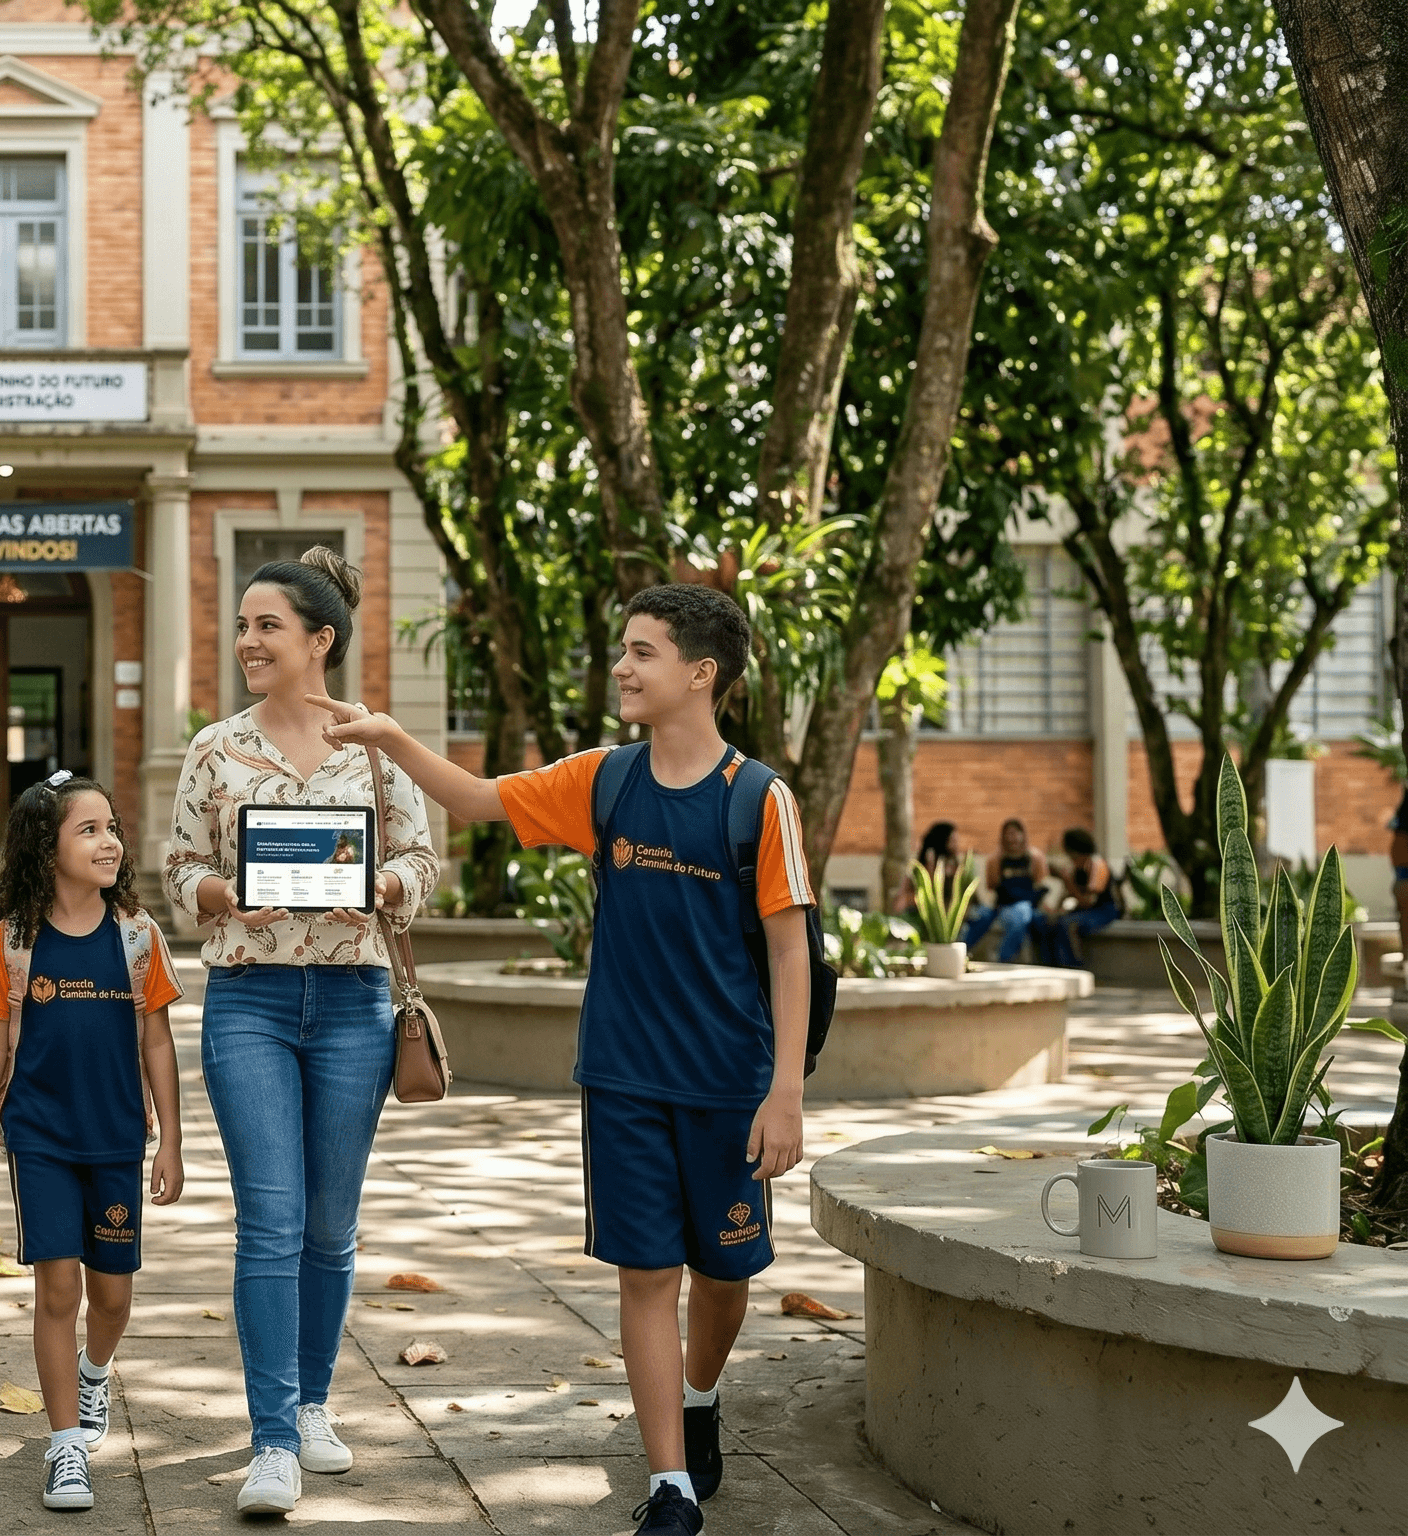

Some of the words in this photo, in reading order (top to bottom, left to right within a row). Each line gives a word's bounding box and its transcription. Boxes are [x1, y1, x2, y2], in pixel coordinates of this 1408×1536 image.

[39, 375, 60, 389] DO
[65, 375, 124, 389] FUTURO
[27, 513, 122, 535] ABERTAS
[673, 862, 686, 873] do
[687, 865, 721, 880] Futuro
[110, 990, 133, 1000] Futur
[1097, 1193, 1131, 1229] M
